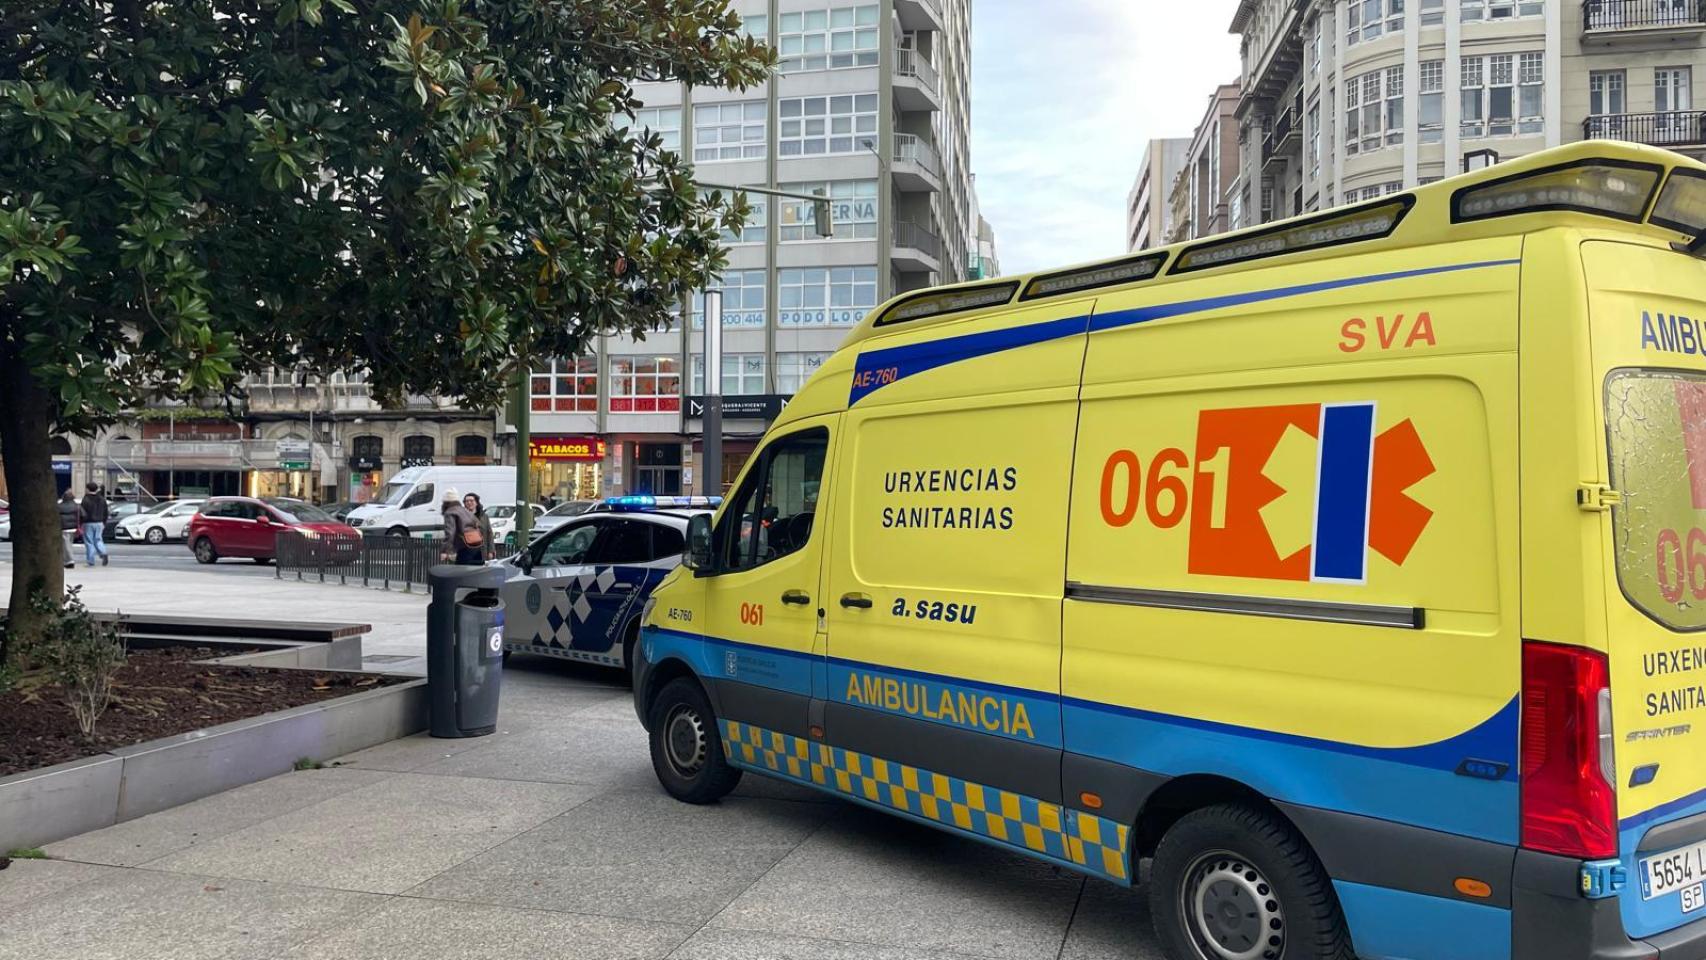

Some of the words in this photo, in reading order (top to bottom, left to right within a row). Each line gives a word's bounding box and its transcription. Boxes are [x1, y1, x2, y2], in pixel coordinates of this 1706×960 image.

[796, 203, 875, 221] LAERNA
[1338, 312, 1436, 353] SVA
[1641, 310, 1706, 356] AMBU
[853, 367, 898, 389] AE-760
[539, 445, 589, 454] TABACOS
[884, 467, 1018, 494] URXENCIAS
[1100, 446, 1232, 529] 061
[882, 506, 1014, 530] SANITARIAS
[667, 608, 693, 622] AE-760
[740, 602, 763, 626] 061
[1643, 646, 1706, 677] URXEN
[846, 673, 1035, 739] AMBULANCIA
[1646, 686, 1706, 717] SANITA
[1625, 724, 1692, 743] SPRINTER
[1653, 852, 1692, 890] 5654
[1683, 885, 1701, 909] SP
